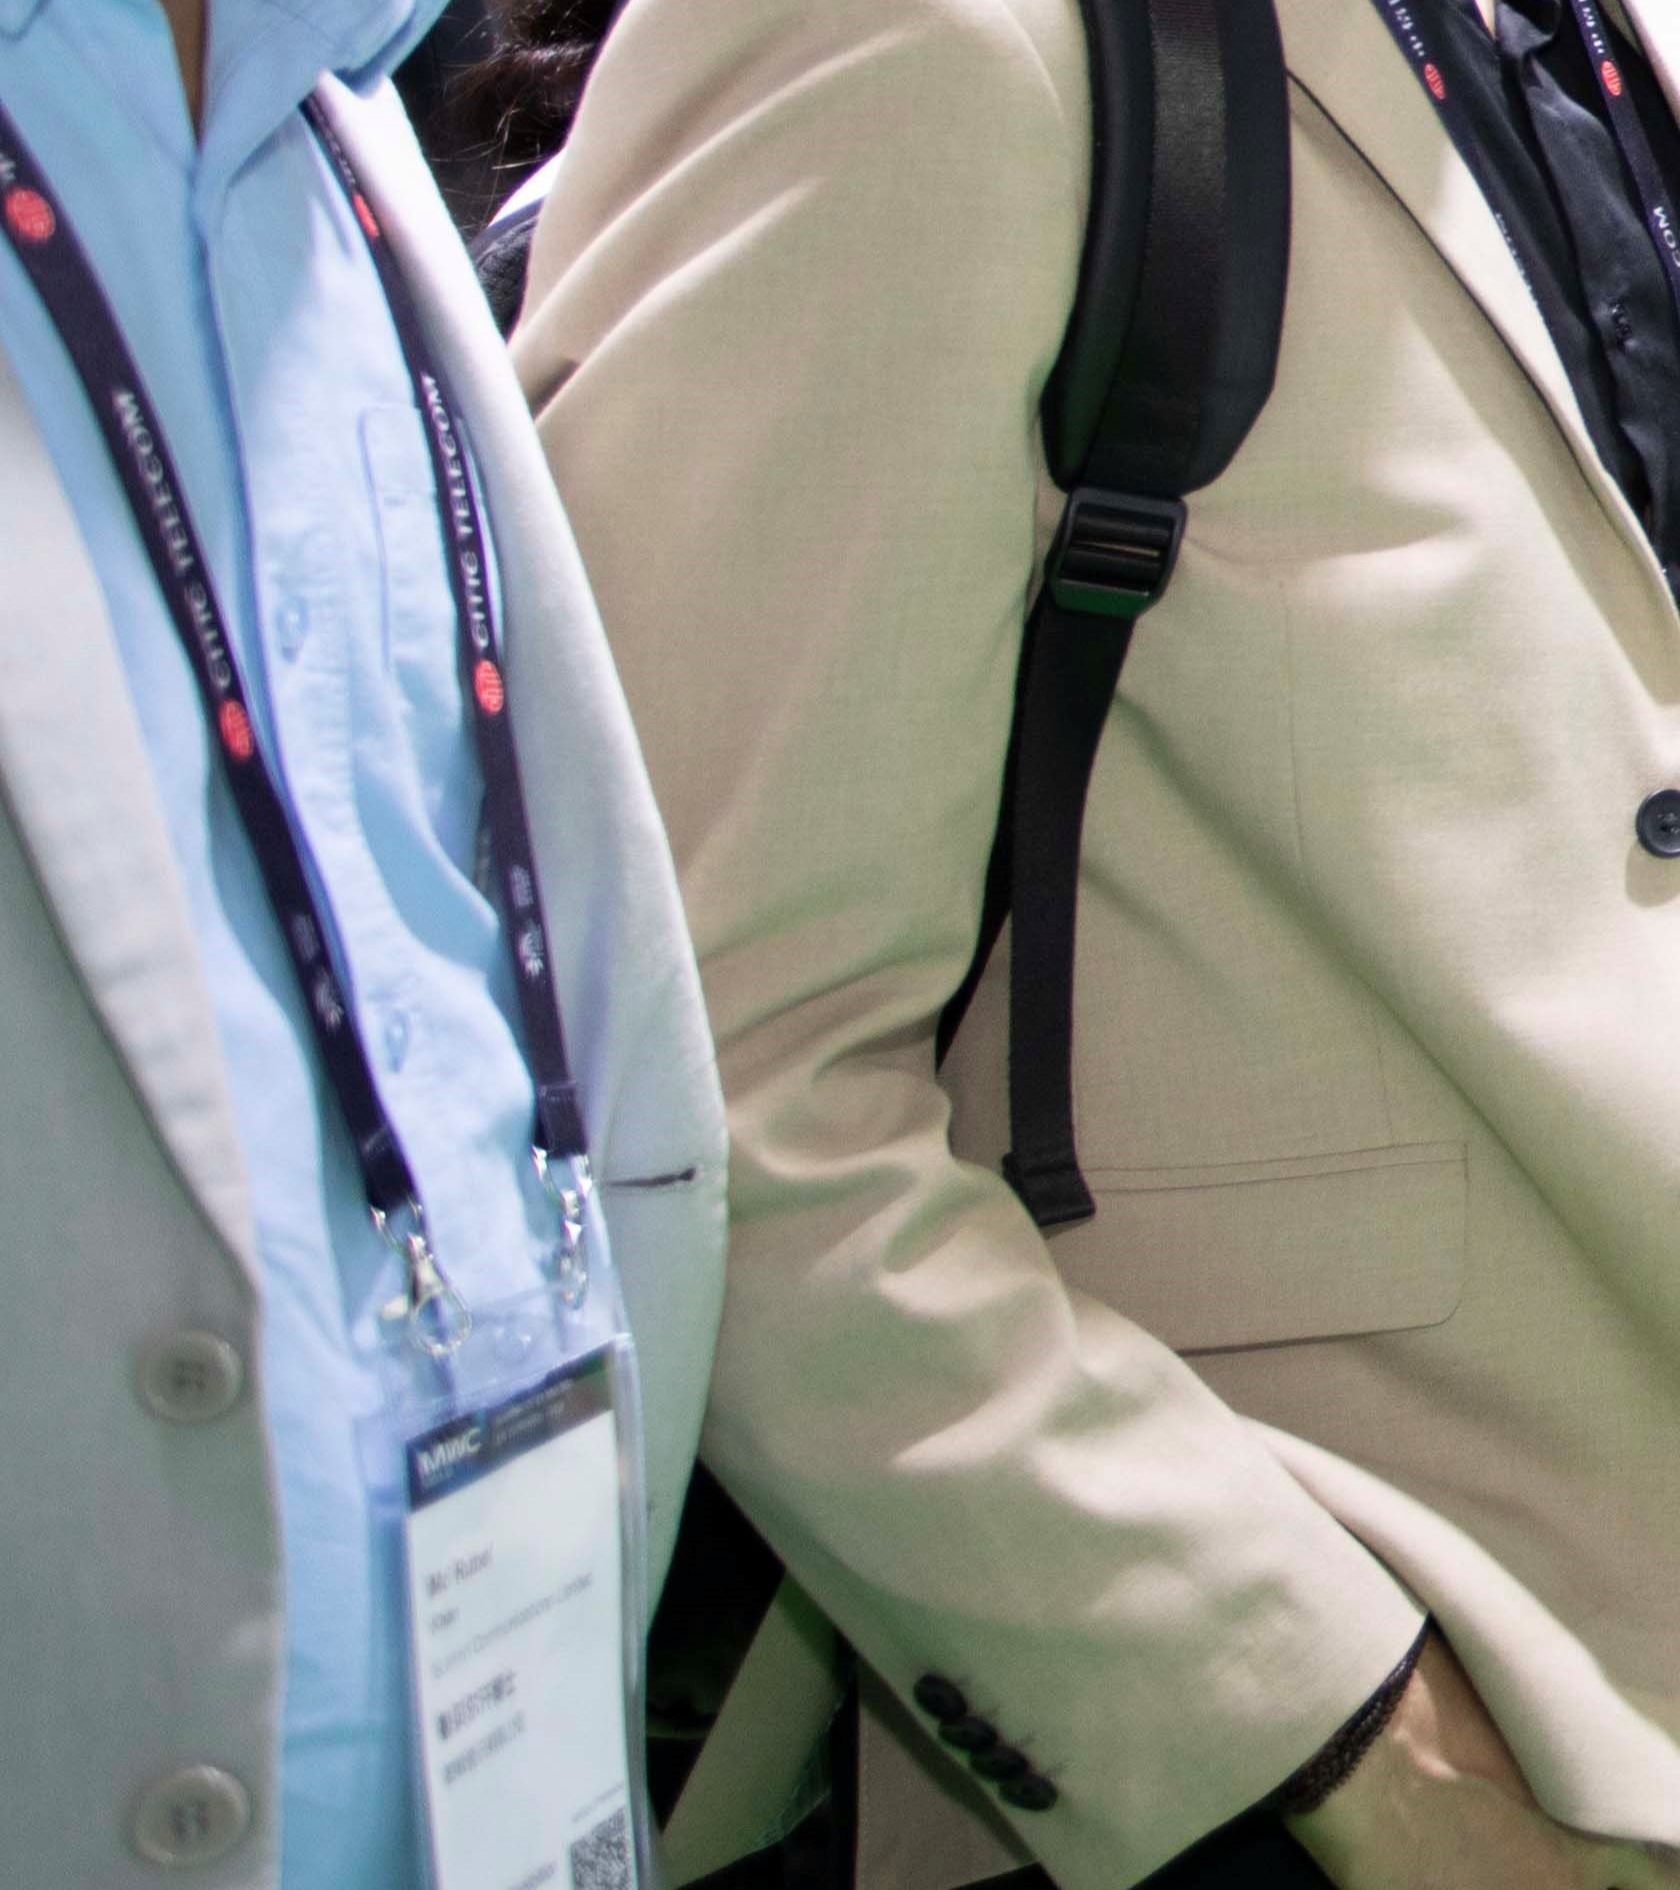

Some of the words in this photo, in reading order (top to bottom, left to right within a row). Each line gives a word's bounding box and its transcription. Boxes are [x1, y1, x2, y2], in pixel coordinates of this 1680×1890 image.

[112, 387, 198, 580] TELECOM
[420, 372, 466, 546] TELECOM
[187, 578, 232, 691] CITIC
[457, 551, 490, 650] CITIC
